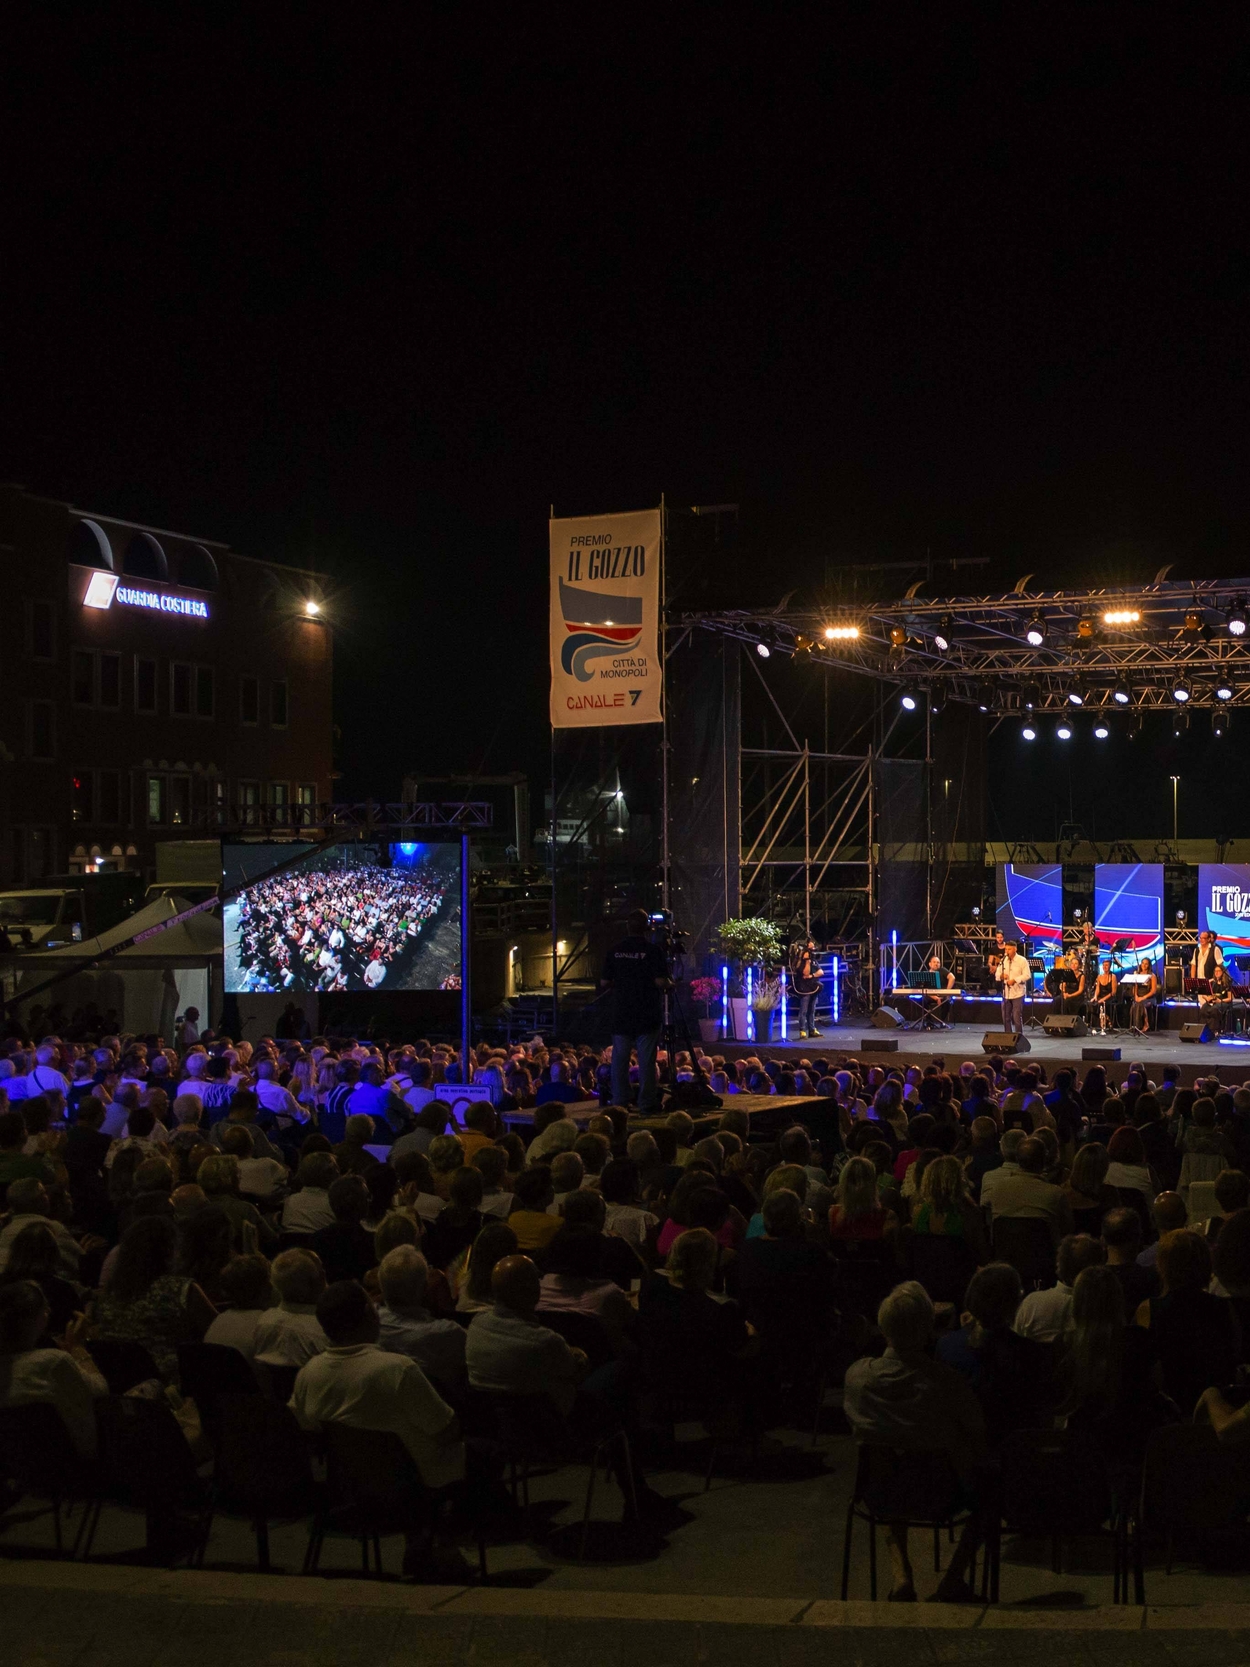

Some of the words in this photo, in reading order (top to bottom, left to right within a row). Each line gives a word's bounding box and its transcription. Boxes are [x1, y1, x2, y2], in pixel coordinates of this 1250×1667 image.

[570, 534, 612, 547] PREMIO
[568, 550, 583, 581] IL
[588, 545, 645, 580] GOZZO
[116, 587, 160, 609] GUARDIA
[160, 595, 208, 617] COSTIERA
[612, 657, 636, 668] CITTÀ
[638, 658, 647, 667] DI
[600, 668, 648, 679] MONOPOLI
[566, 693, 625, 710] CANALE
[628, 690, 643, 706] 7
[1211, 885, 1240, 893] PREMIO
[1211, 892, 1223, 912] IL
